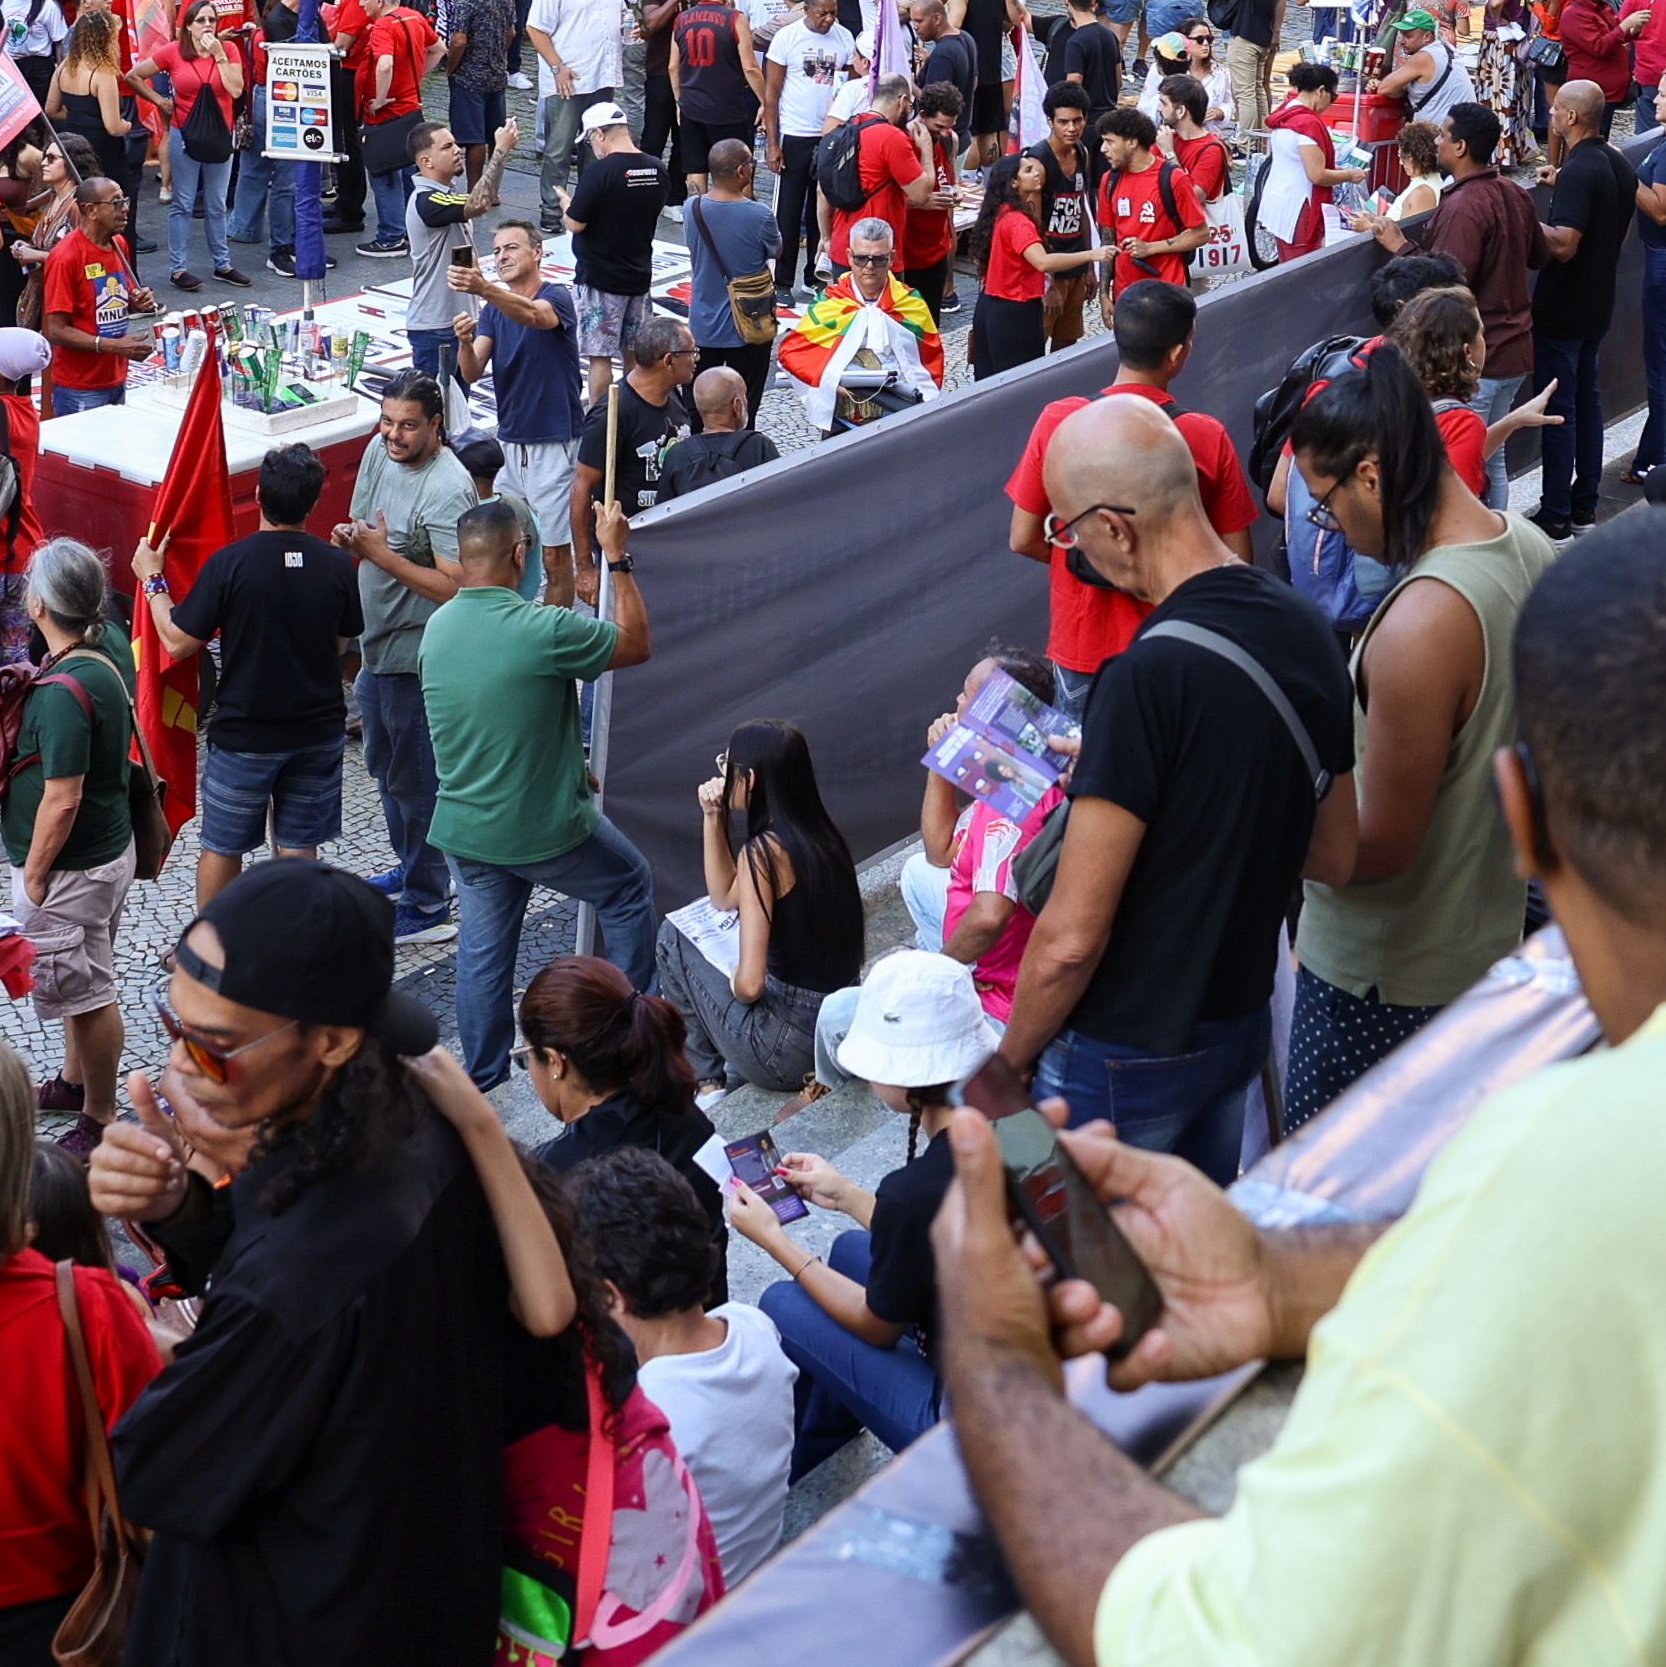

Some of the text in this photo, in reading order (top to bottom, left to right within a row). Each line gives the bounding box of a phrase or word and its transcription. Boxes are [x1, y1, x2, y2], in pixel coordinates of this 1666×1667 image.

[685, 28, 715, 67] 10
[272, 57, 328, 69] ACEITAMOS
[276, 68, 322, 79] CARTÕES
[306, 89, 322, 97] VISA
[305, 133, 322, 143] elo
[1208, 224, 1232, 244] 25
[1199, 245, 1241, 268] 1917
